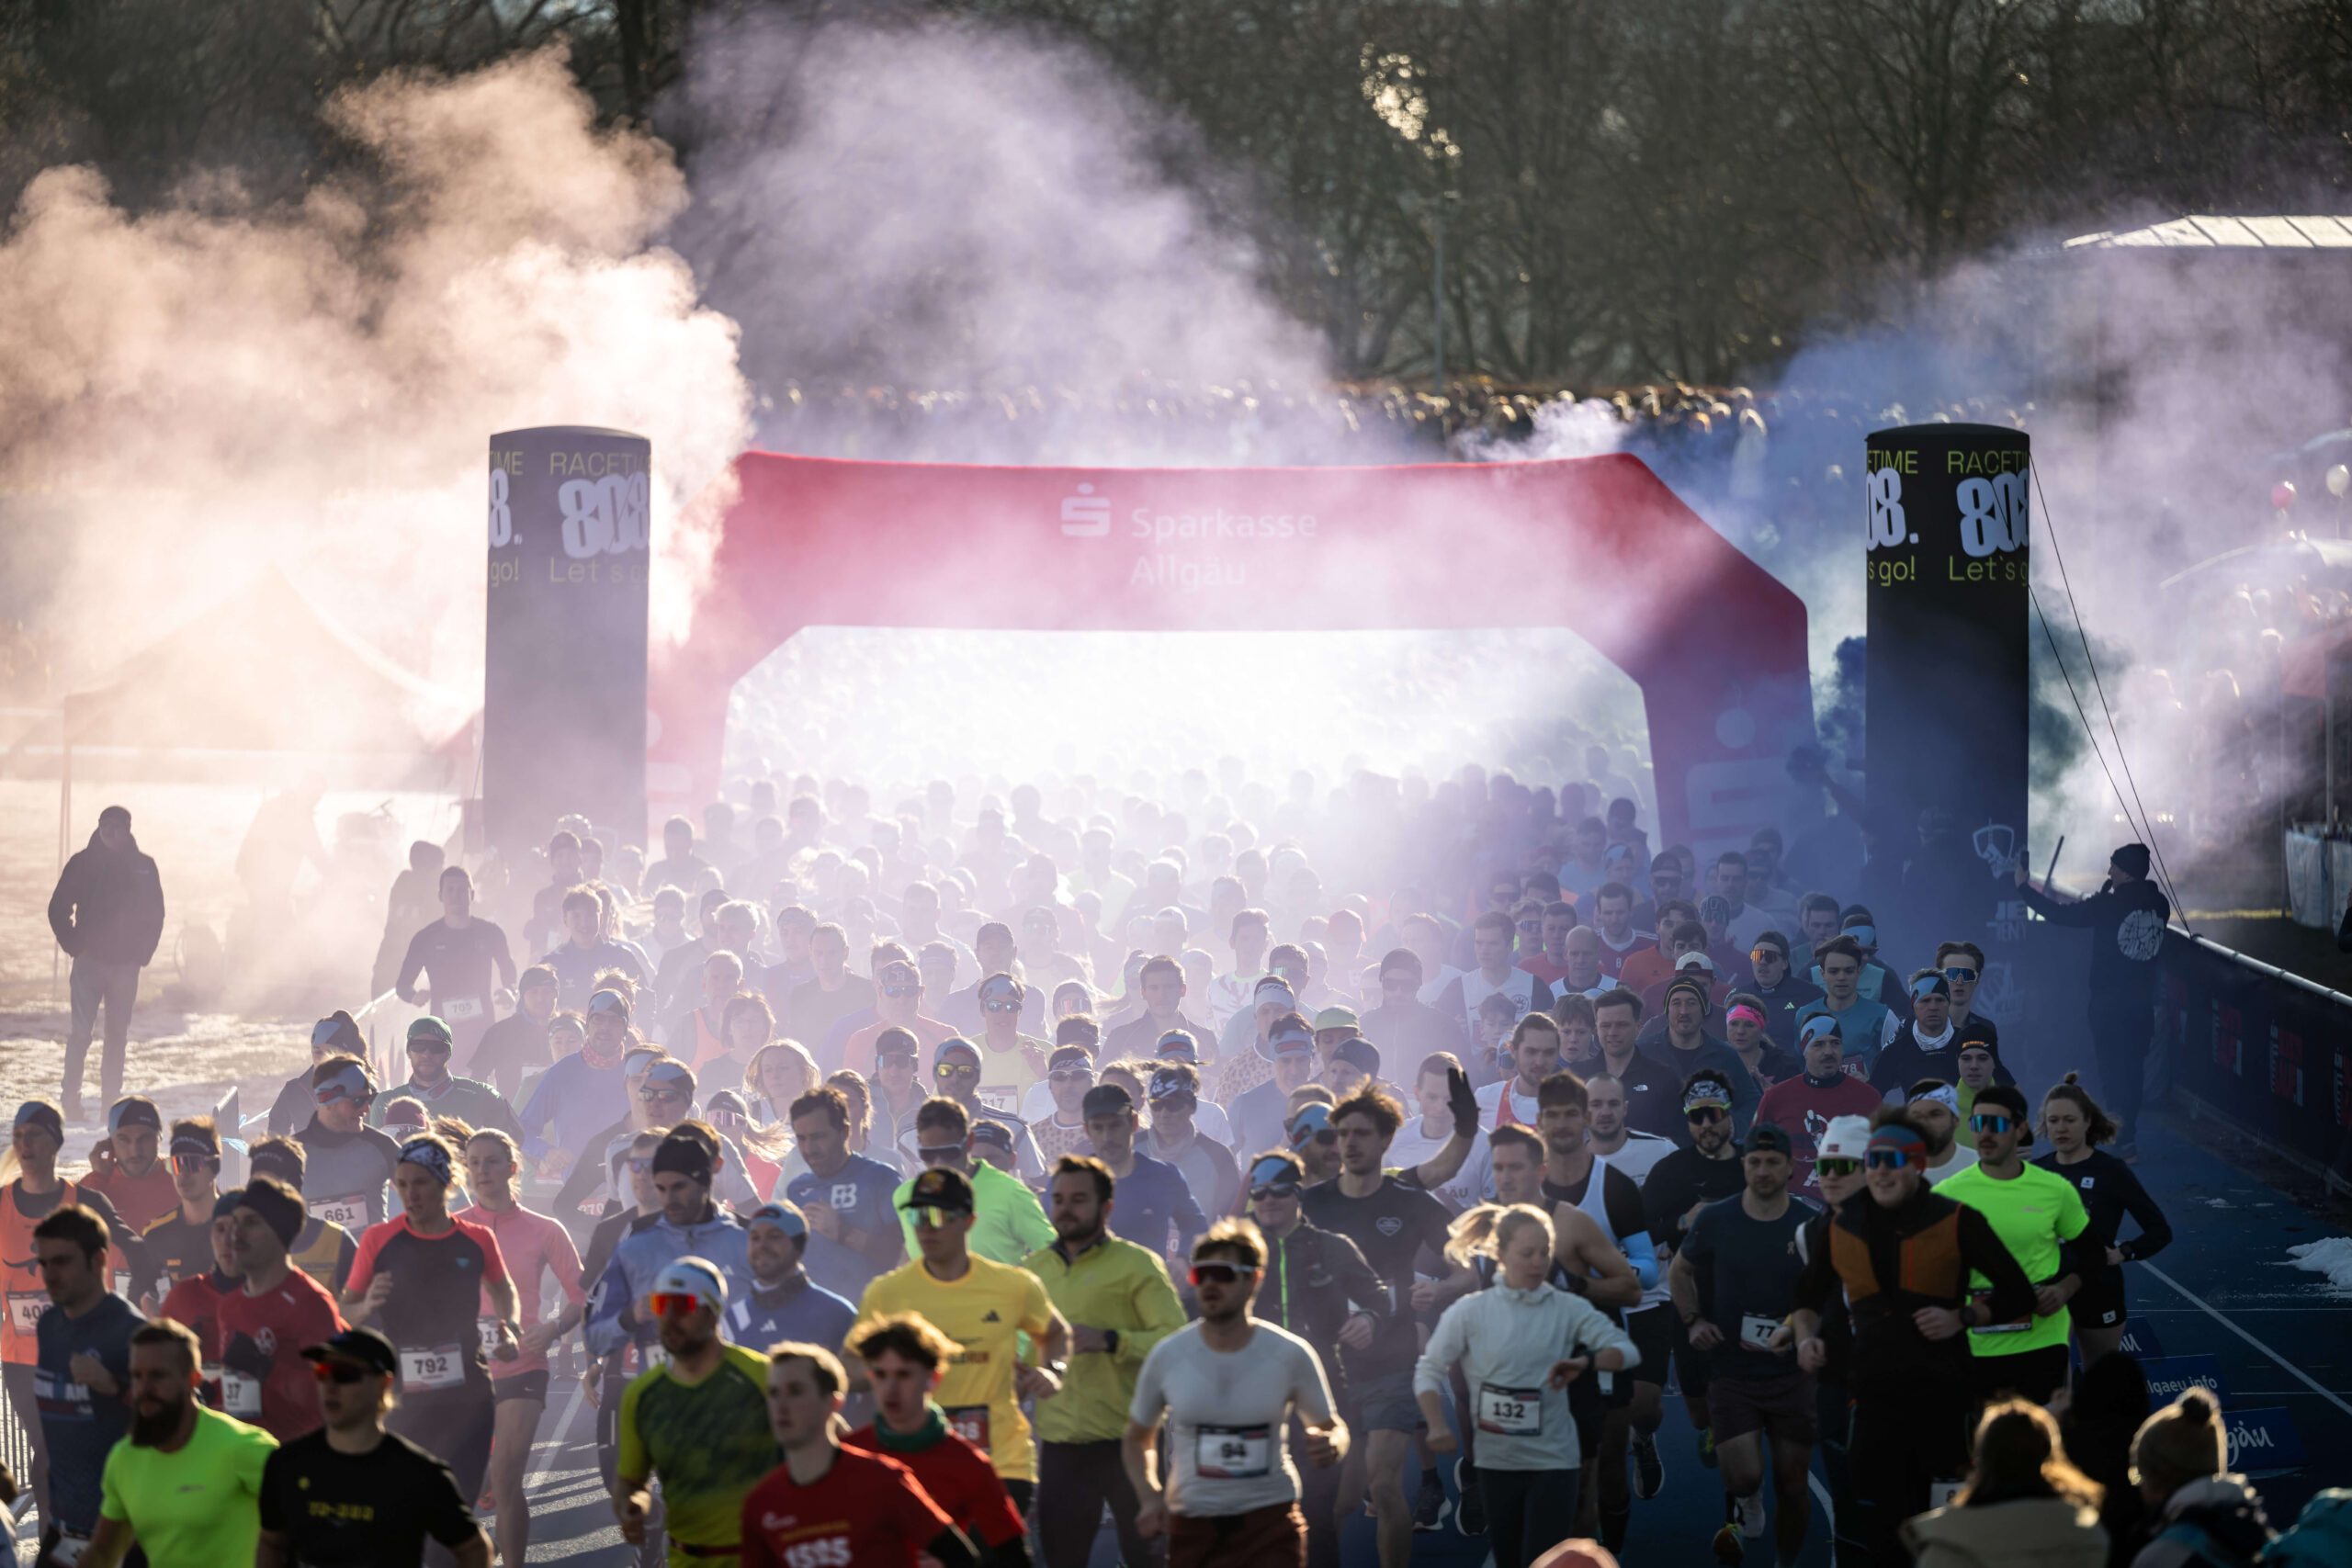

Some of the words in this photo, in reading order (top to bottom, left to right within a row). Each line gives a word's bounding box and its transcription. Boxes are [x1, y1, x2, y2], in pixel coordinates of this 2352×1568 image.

[488, 467, 523, 551] 8.
[1130, 506, 1317, 545] Sparkasse
[1129, 554, 1247, 594] Allgäu
[1879, 554, 1917, 587] go!
[324, 1206, 356, 1223] 661
[413, 1356, 448, 1375] 792
[1492, 1401, 1525, 1419] 132
